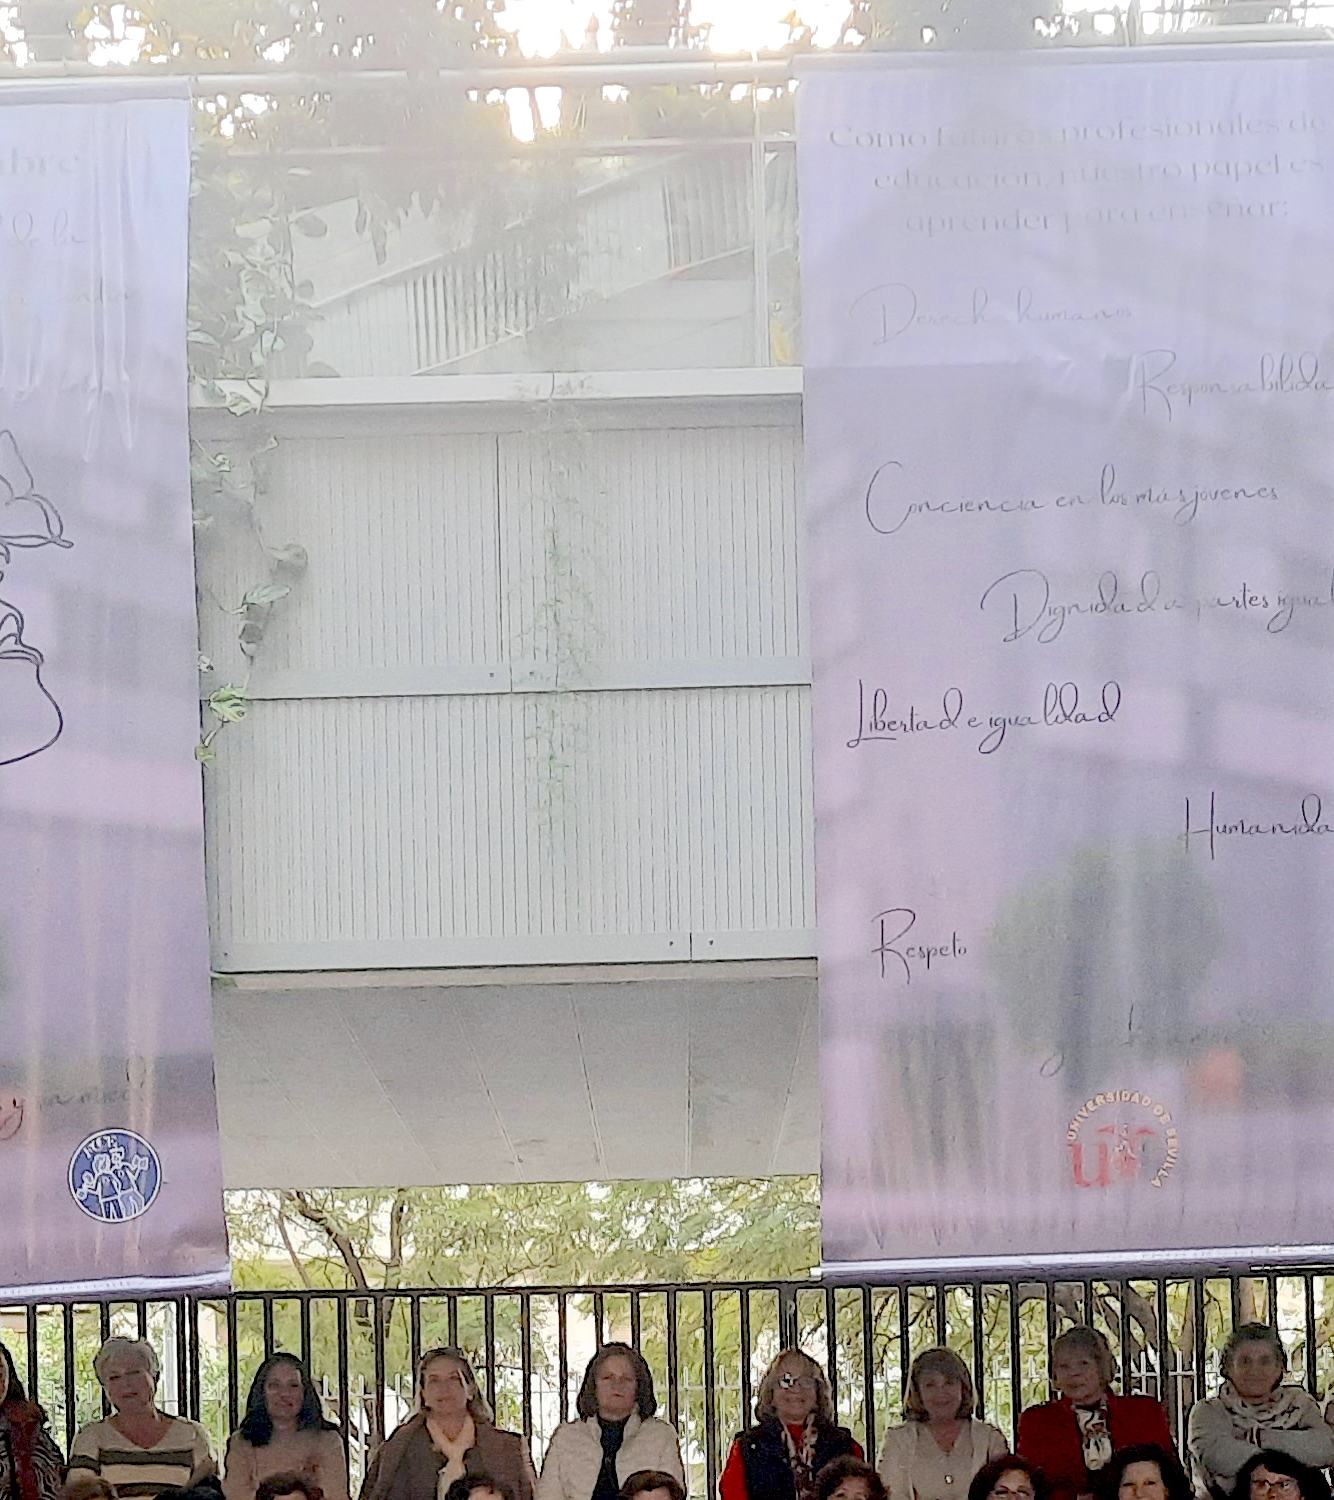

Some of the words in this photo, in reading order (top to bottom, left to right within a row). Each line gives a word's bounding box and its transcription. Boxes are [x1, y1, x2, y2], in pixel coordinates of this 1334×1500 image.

[828, 124, 926, 148] Como
[1061, 112, 1280, 142] profesionales
[1288, 111, 1326, 133] de
[1191, 153, 1280, 183] papel
[1289, 157, 1326, 174] es
[905, 208, 1049, 238] aprender
[864, 460, 1046, 535] Conciencia
[1055, 494, 1086, 509] en
[979, 568, 1161, 644] Dignidad
[847, 678, 965, 748] Libertad
[967, 714, 981, 729] e
[978, 681, 1123, 755] igualdad
[870, 907, 969, 986] Respeto
[1067, 1089, 1152, 1141] UNIVERSIDAD
